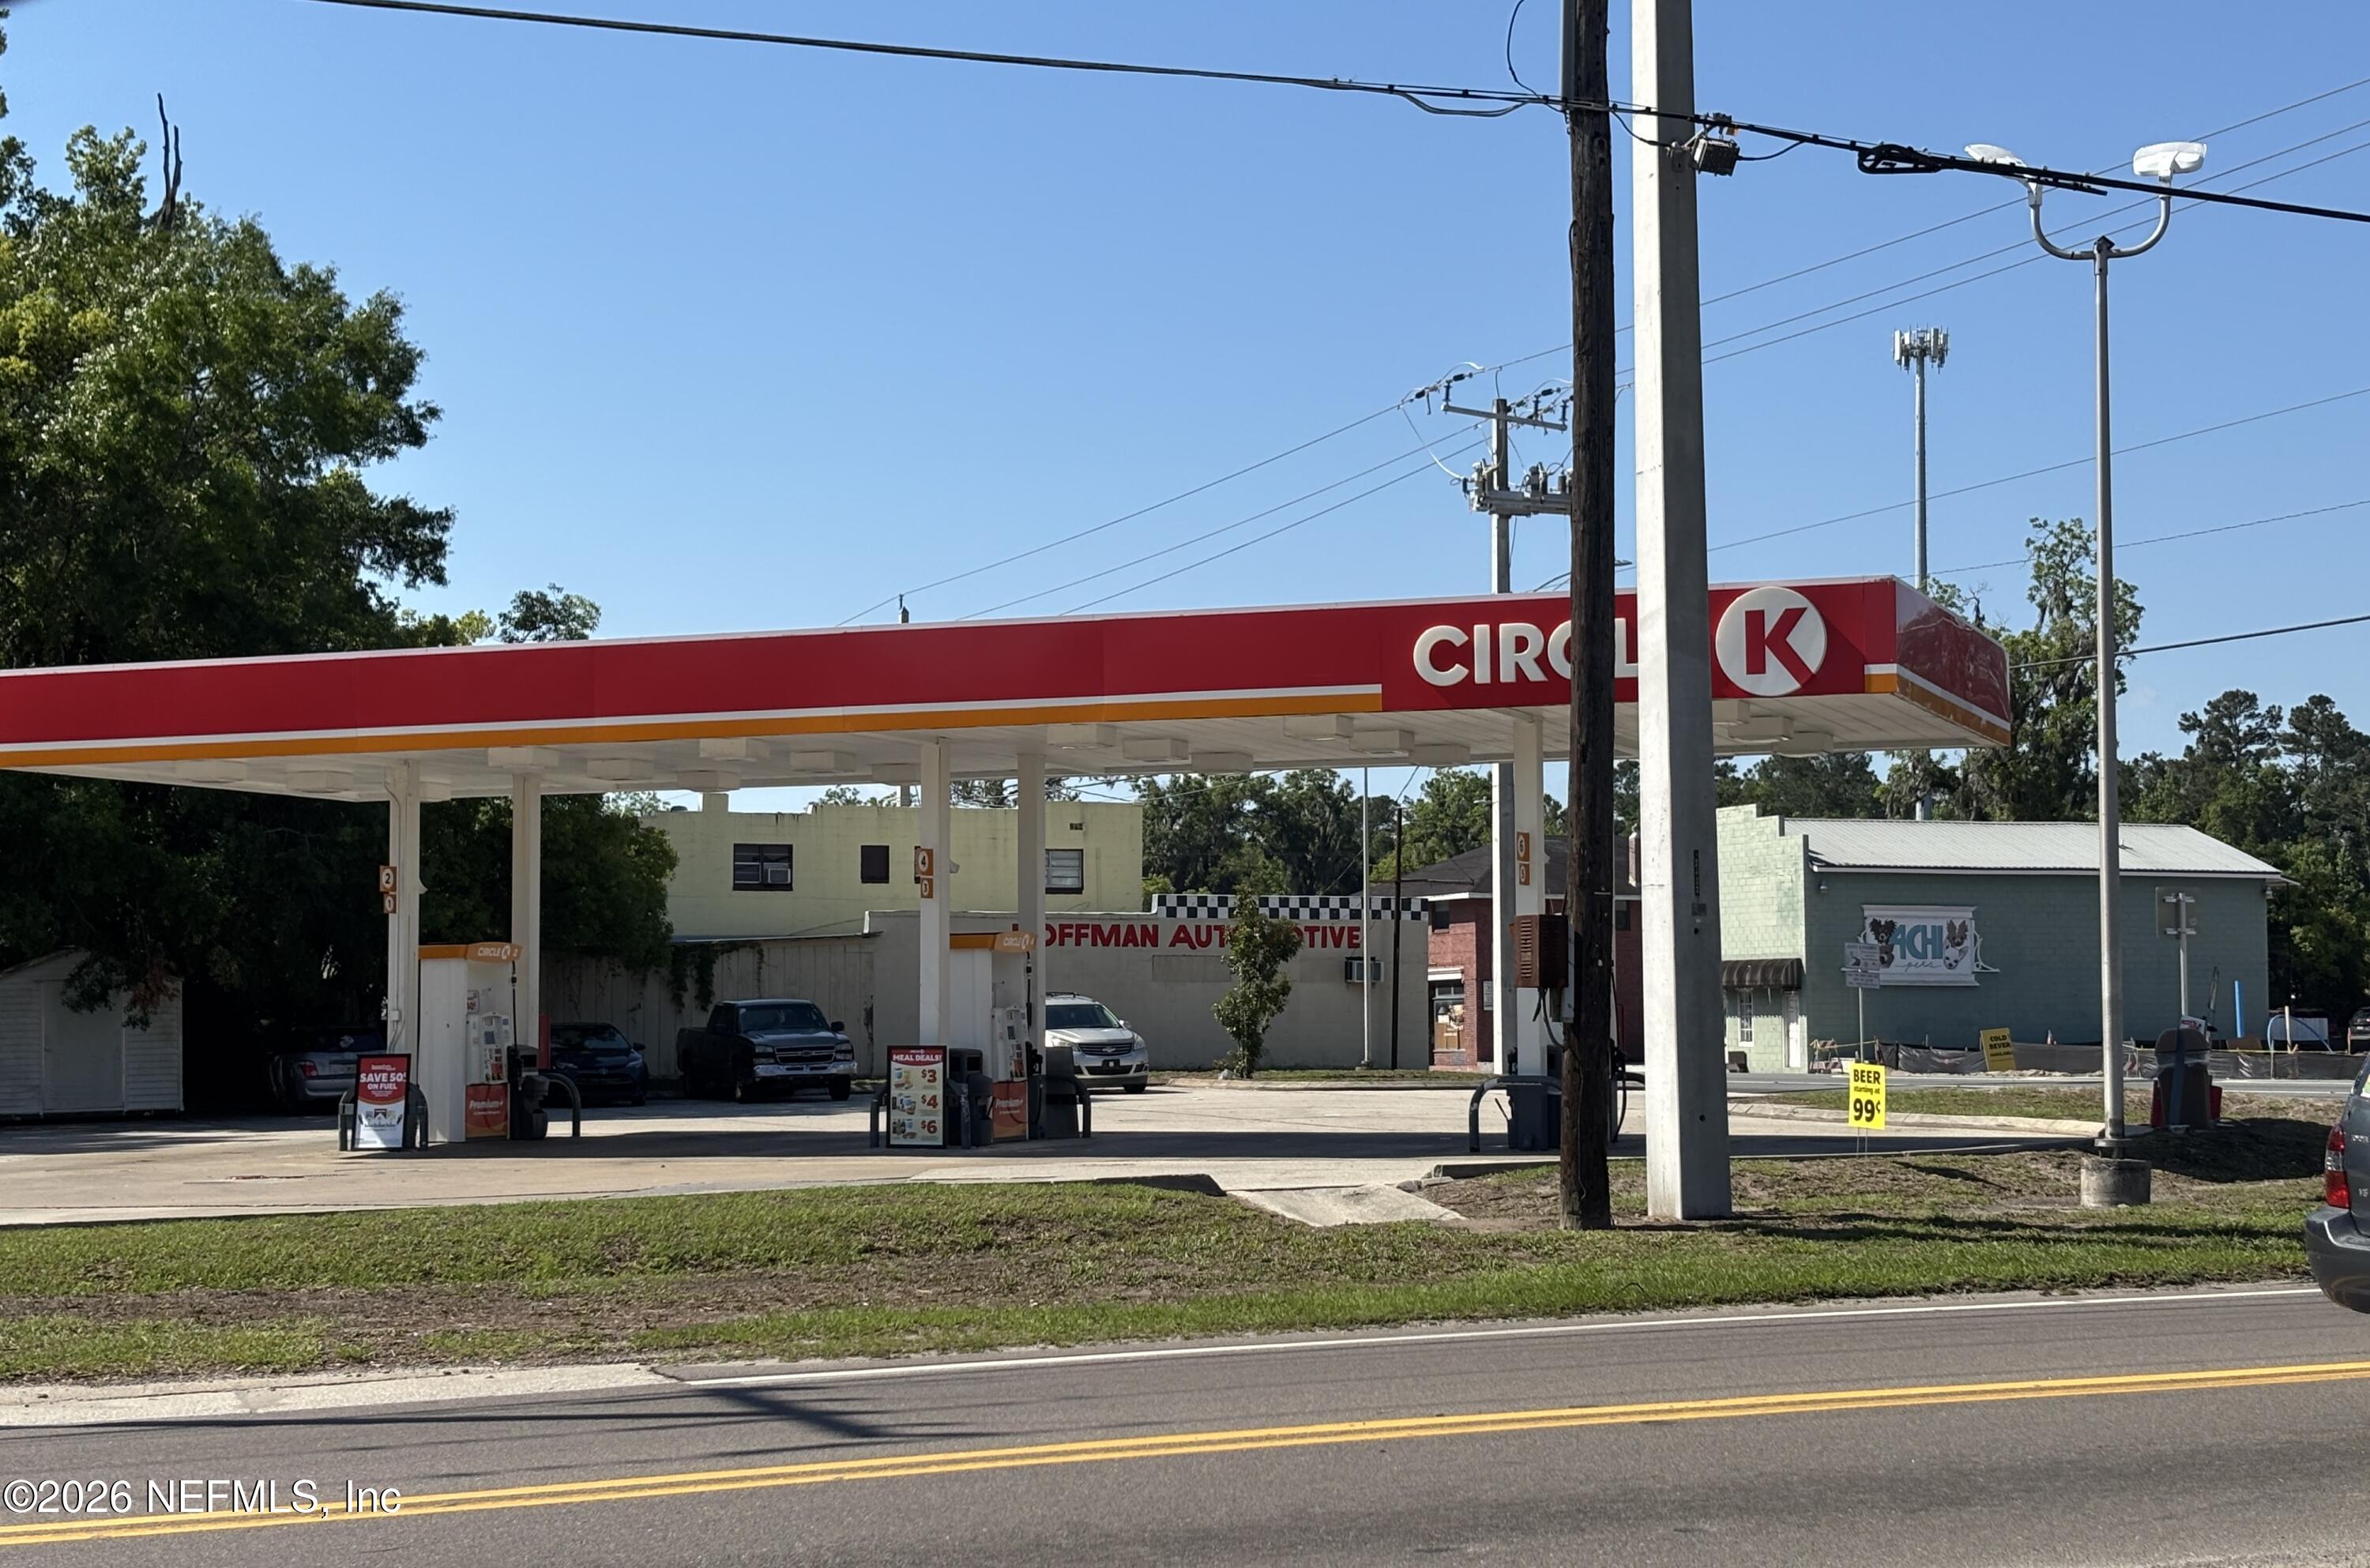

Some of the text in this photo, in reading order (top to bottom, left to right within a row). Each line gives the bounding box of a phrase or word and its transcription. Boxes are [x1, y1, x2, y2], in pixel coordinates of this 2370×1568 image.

[1413, 606, 1817, 690] CIRL K
[921, 855, 927, 867] 4
[385, 872, 391, 885] 2
[1012, 923, 1159, 948] OFFMAN
[1169, 924, 1360, 950] AUTTIVE
[360, 1073, 388, 1082] SAVE
[921, 1069, 937, 1084] $3
[1853, 1069, 1881, 1085] BEER
[921, 1094, 939, 1109] $4
[1853, 1098, 1880, 1122] 99¢
[921, 1119, 938, 1134] $6
